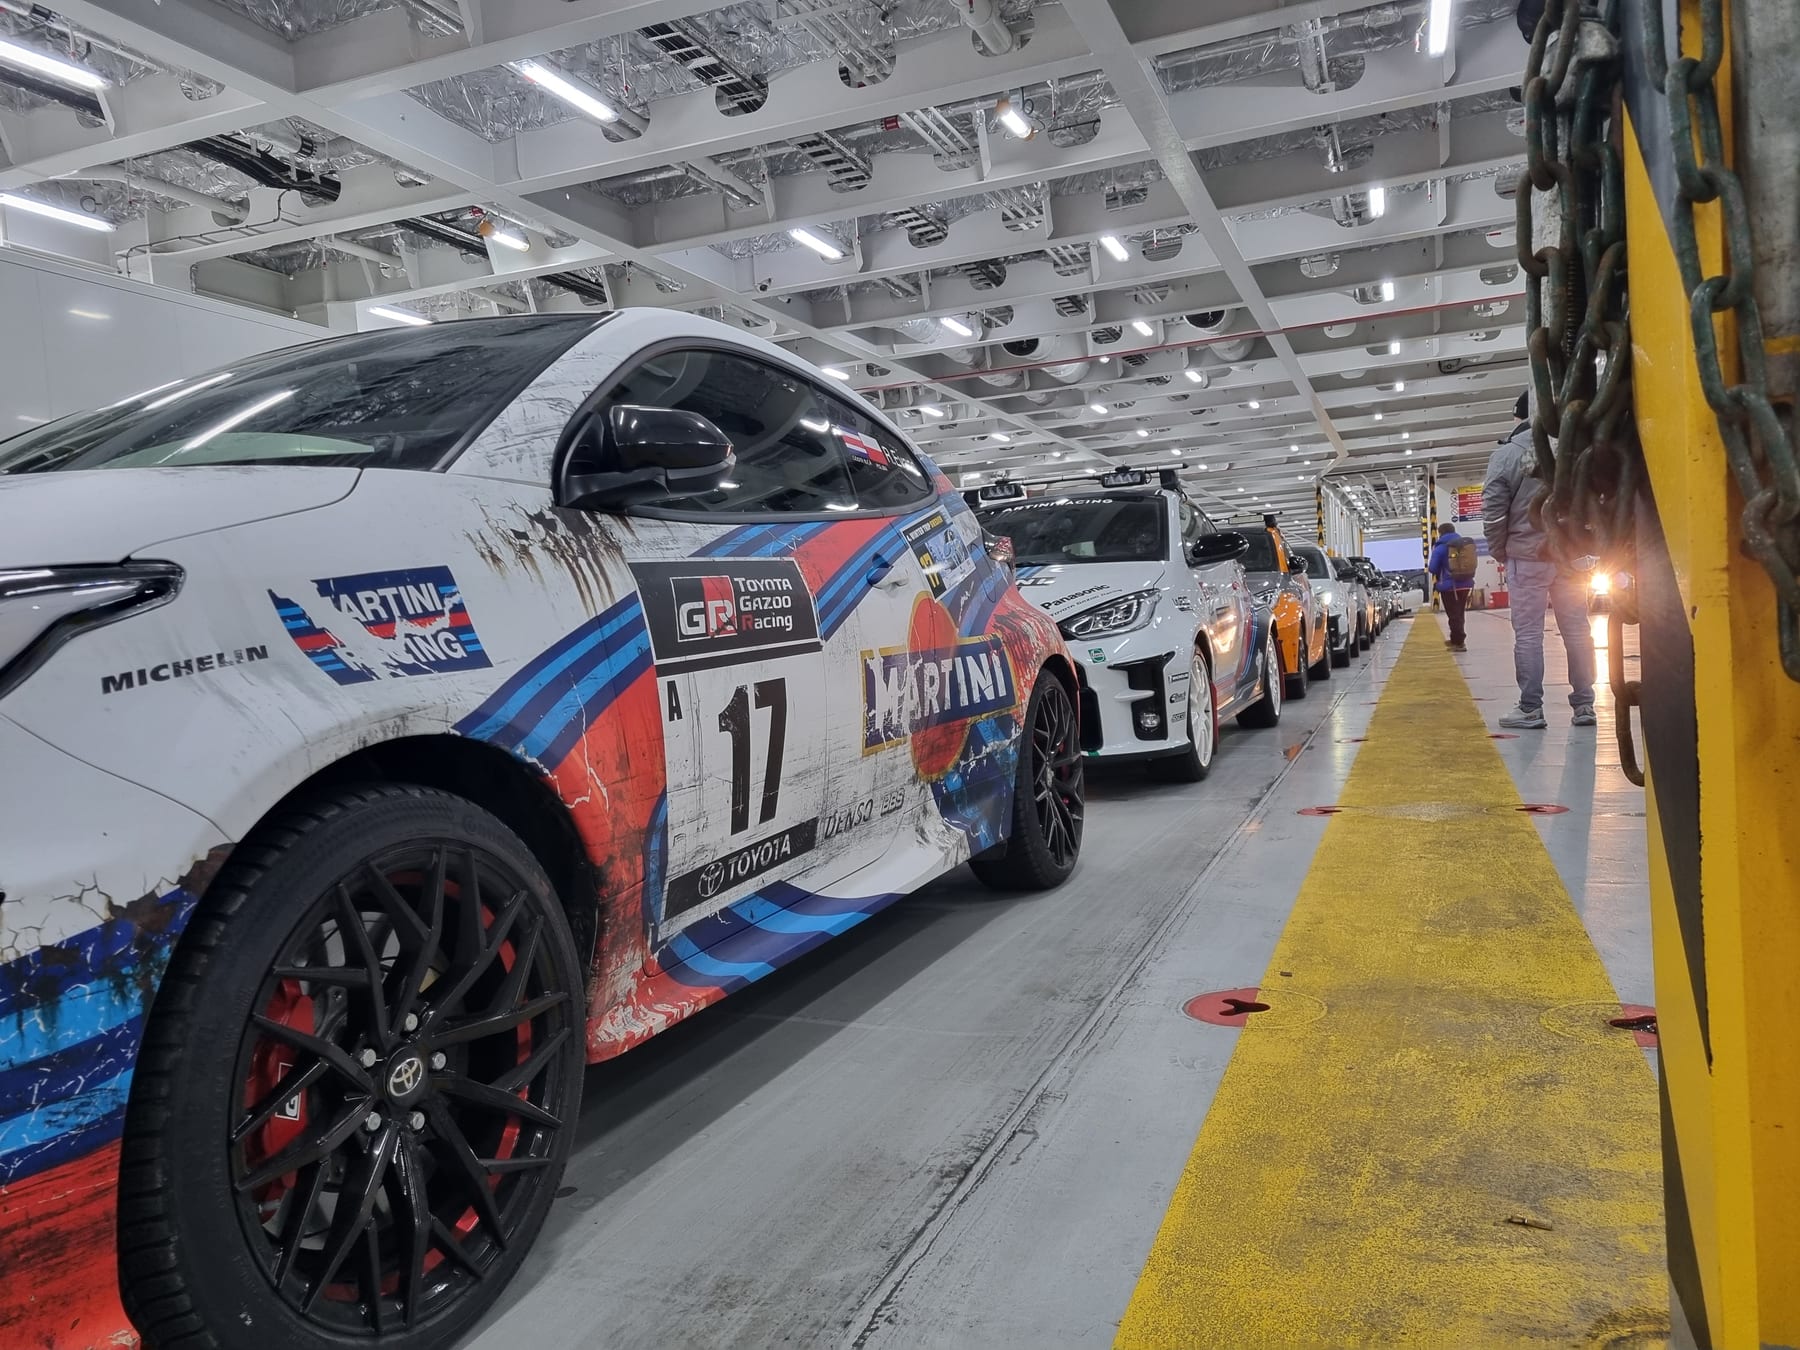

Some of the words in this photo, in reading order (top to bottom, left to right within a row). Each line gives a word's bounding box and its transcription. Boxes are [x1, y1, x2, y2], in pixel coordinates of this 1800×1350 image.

[328, 582, 445, 624] ARTINI
[734, 577, 793, 592] TOYOTA
[739, 595, 792, 612] GAZOO
[1040, 584, 1110, 610] Panasonic
[679, 599, 734, 636] GR
[741, 612, 793, 632] Racing
[100, 644, 270, 695] MICHELIN
[666, 679, 683, 722] A
[868, 652, 1008, 730] MARTINI
[717, 676, 788, 837] 17
[823, 798, 874, 840] DENSO
[727, 833, 792, 882] TOYOTA
